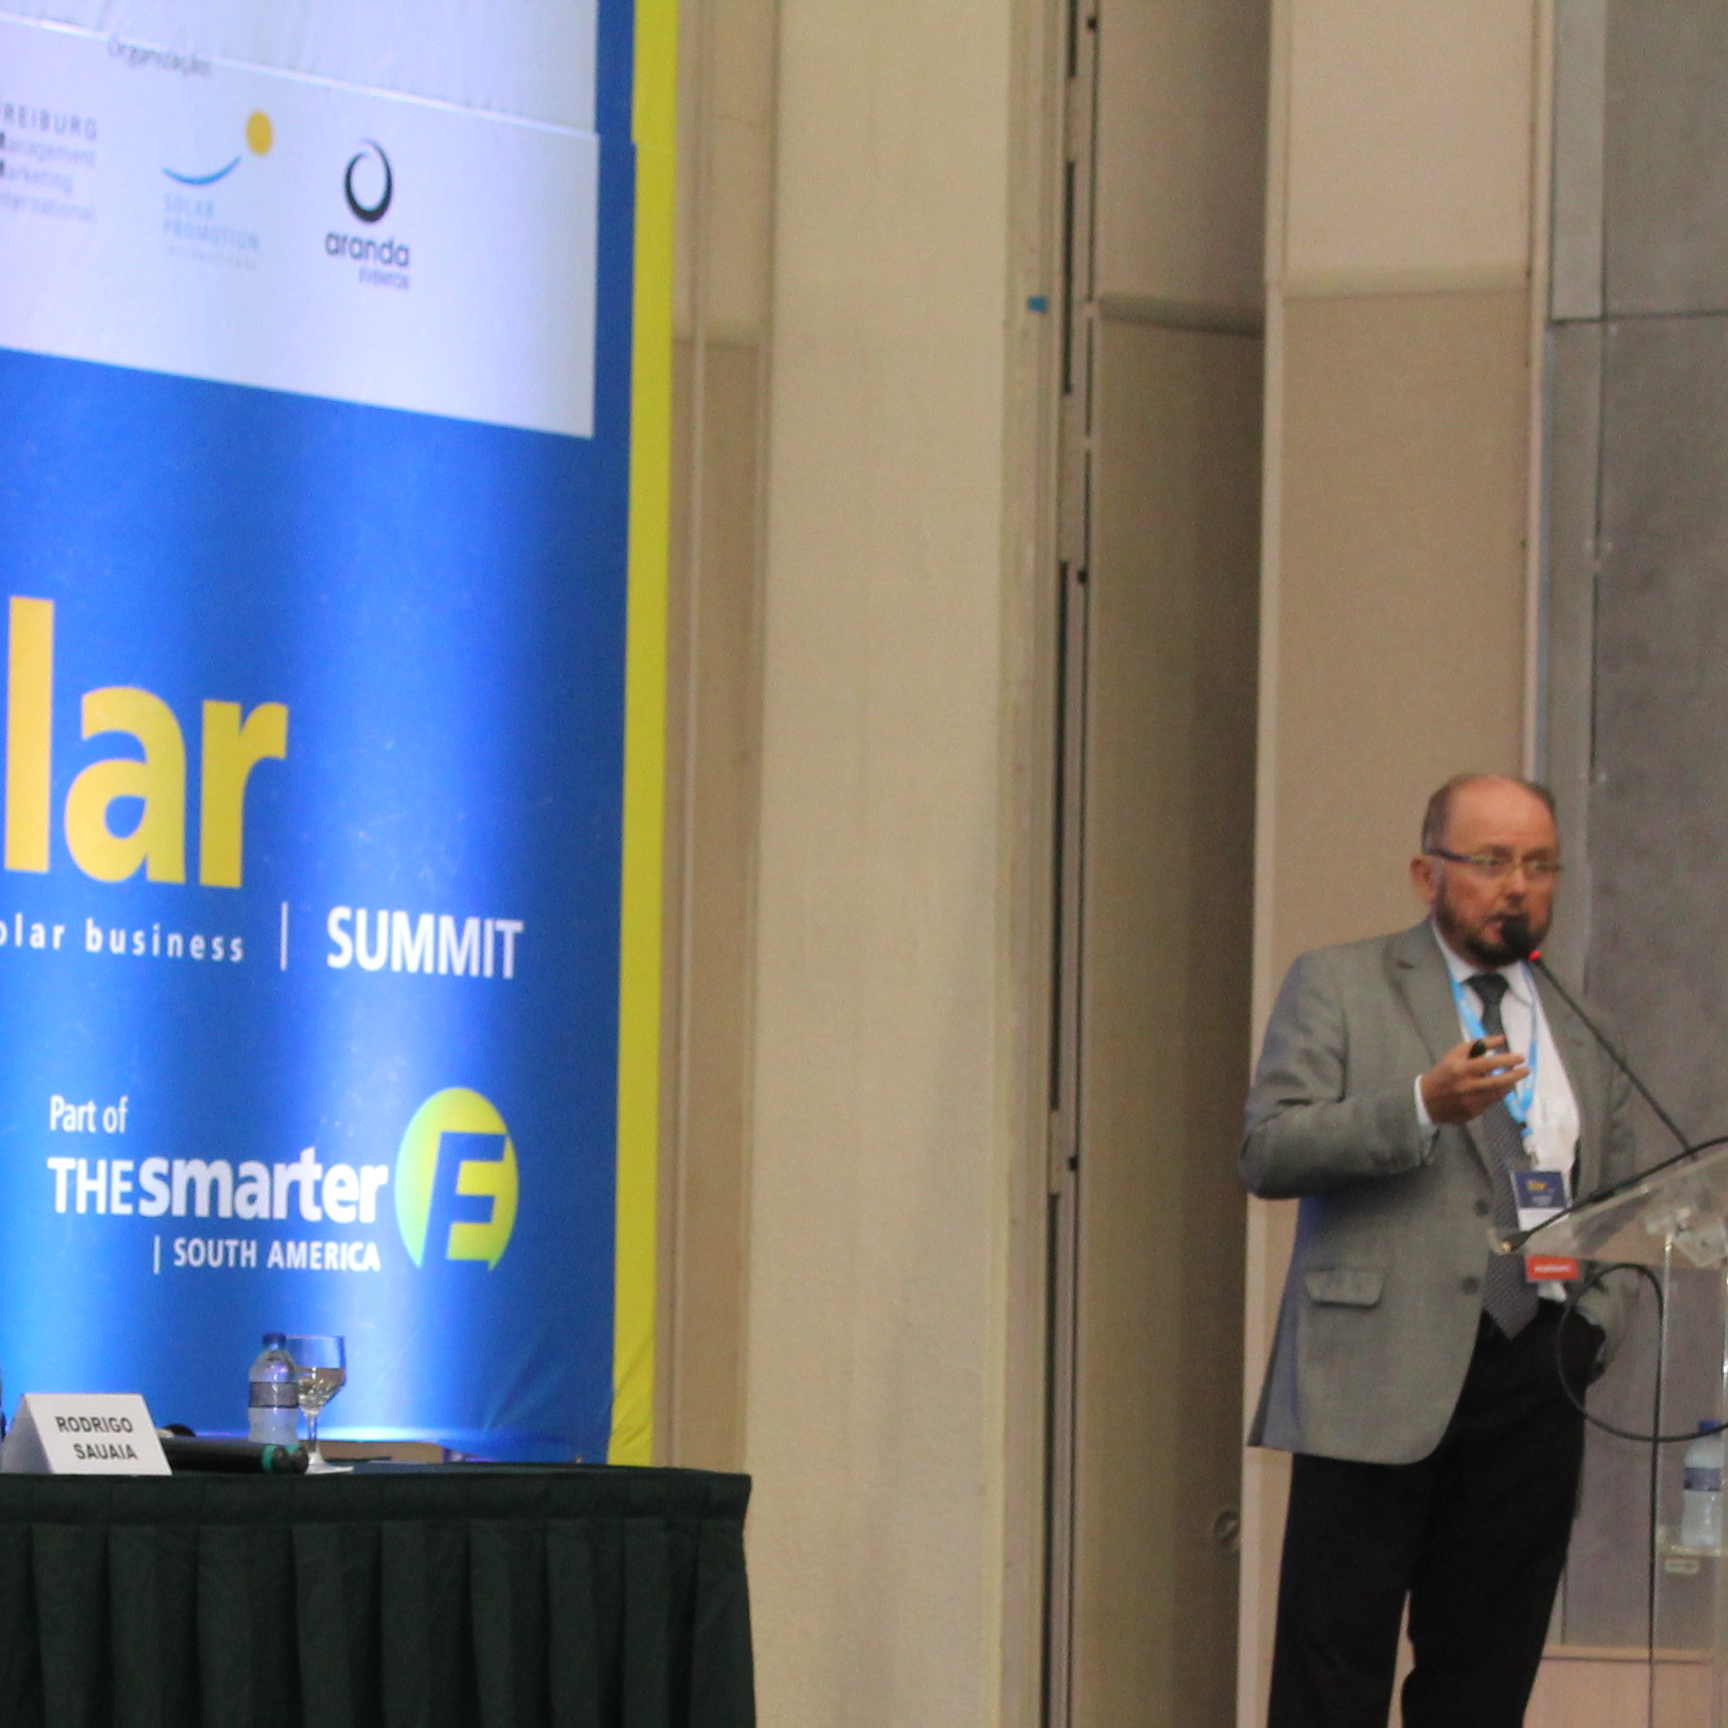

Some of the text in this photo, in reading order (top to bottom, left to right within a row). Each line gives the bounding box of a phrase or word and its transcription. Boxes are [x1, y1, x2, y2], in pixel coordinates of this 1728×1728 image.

[325, 231, 411, 268] aranda
[85, 918, 245, 963] business
[326, 904, 525, 980] SUMMIT
[49, 1094, 129, 1134] Part of
[173, 1237, 381, 1272] SOUTH AMERICA
[55, 1416, 134, 1434] RODRIGO
[73, 1444, 139, 1460] SAUAIA
